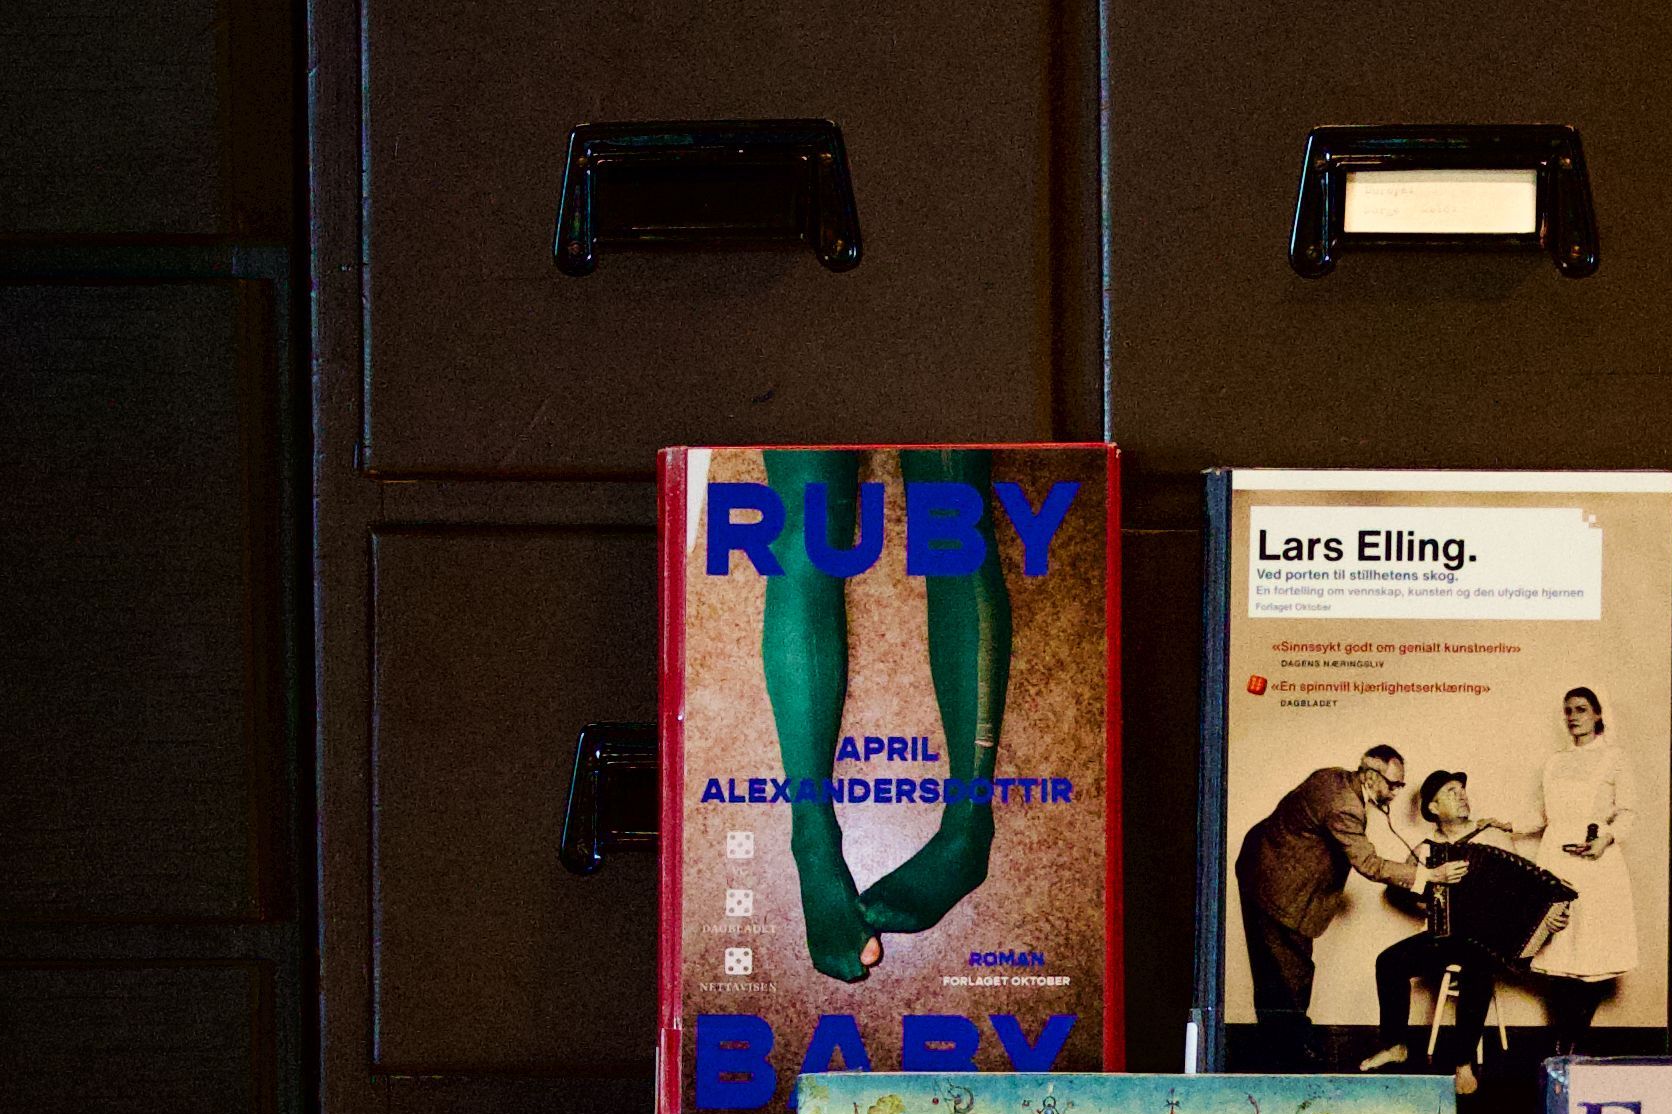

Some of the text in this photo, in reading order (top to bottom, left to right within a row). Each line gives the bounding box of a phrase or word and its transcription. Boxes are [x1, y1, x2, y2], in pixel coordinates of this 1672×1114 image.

[705, 481, 1081, 578] RUBY
[1258, 529, 1478, 571] Lars Elling.
[1257, 569, 1459, 584] Ved porten til stillhetens skog.
[1256, 585, 1271, 596] En
[1274, 585, 1324, 598] fortelling
[1327, 587, 1345, 596] om
[1348, 586, 1404, 598] vennskap,
[1408, 587, 1453, 598] kunsten
[1456, 589, 1470, 599] og
[1474, 588, 1494, 598] den
[1272, 640, 1521, 656] «Sinnssykt godt om genialt kunstnerliv»
[1281, 660, 1320, 668] DAGENS
[1271, 680, 1491, 696] «En spinnvill kjærlighetserklæring»
[837, 736, 940, 762] APRIL
[701, 777, 1074, 804] ALEXANDERSDOTTIR
[968, 951, 1045, 967] ROMAN
[943, 976, 1071, 986] FORLAGET OKTOBER
